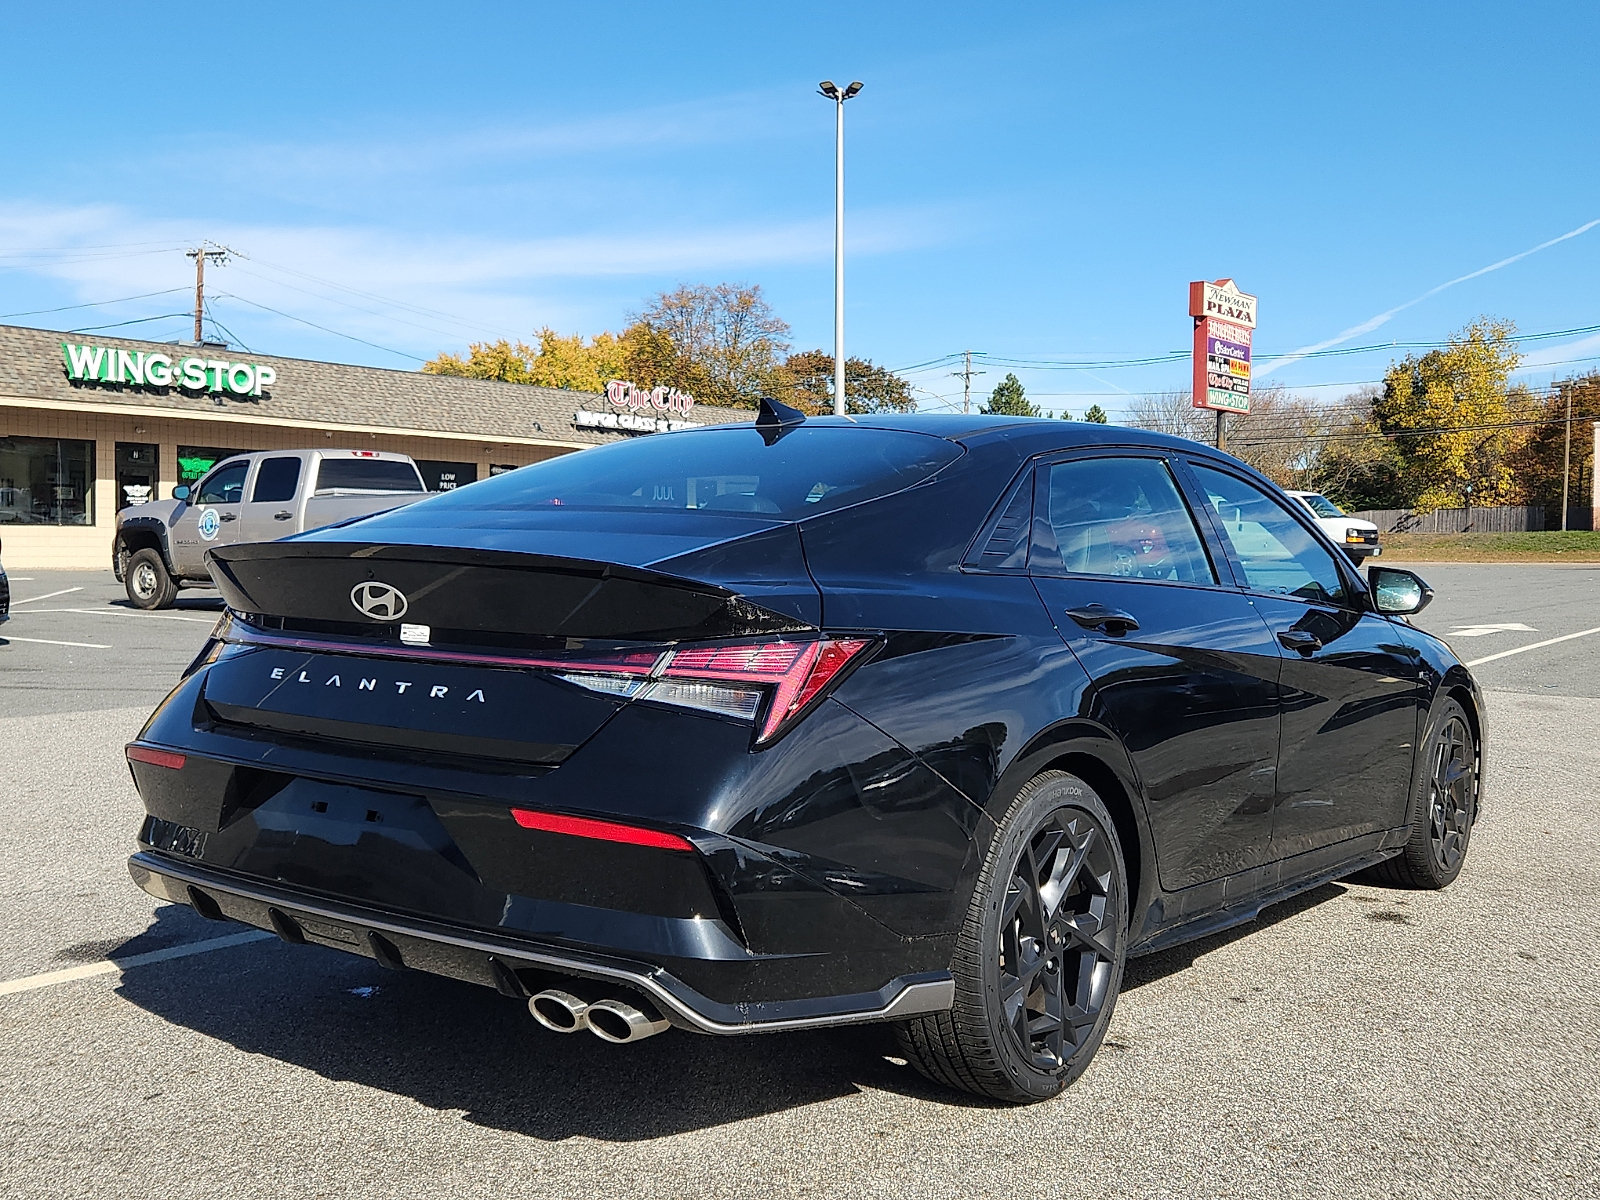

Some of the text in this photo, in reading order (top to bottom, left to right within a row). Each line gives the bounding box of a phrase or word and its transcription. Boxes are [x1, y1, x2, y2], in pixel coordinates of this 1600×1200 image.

[1208, 287, 1252, 309] NEWMAN
[1206, 300, 1253, 323] PLAZA
[606, 380, 695, 418] The City
[440, 482, 458, 490] PRICE
[441, 473, 456, 481] LOW
[270, 666, 486, 704] ELANTRA
